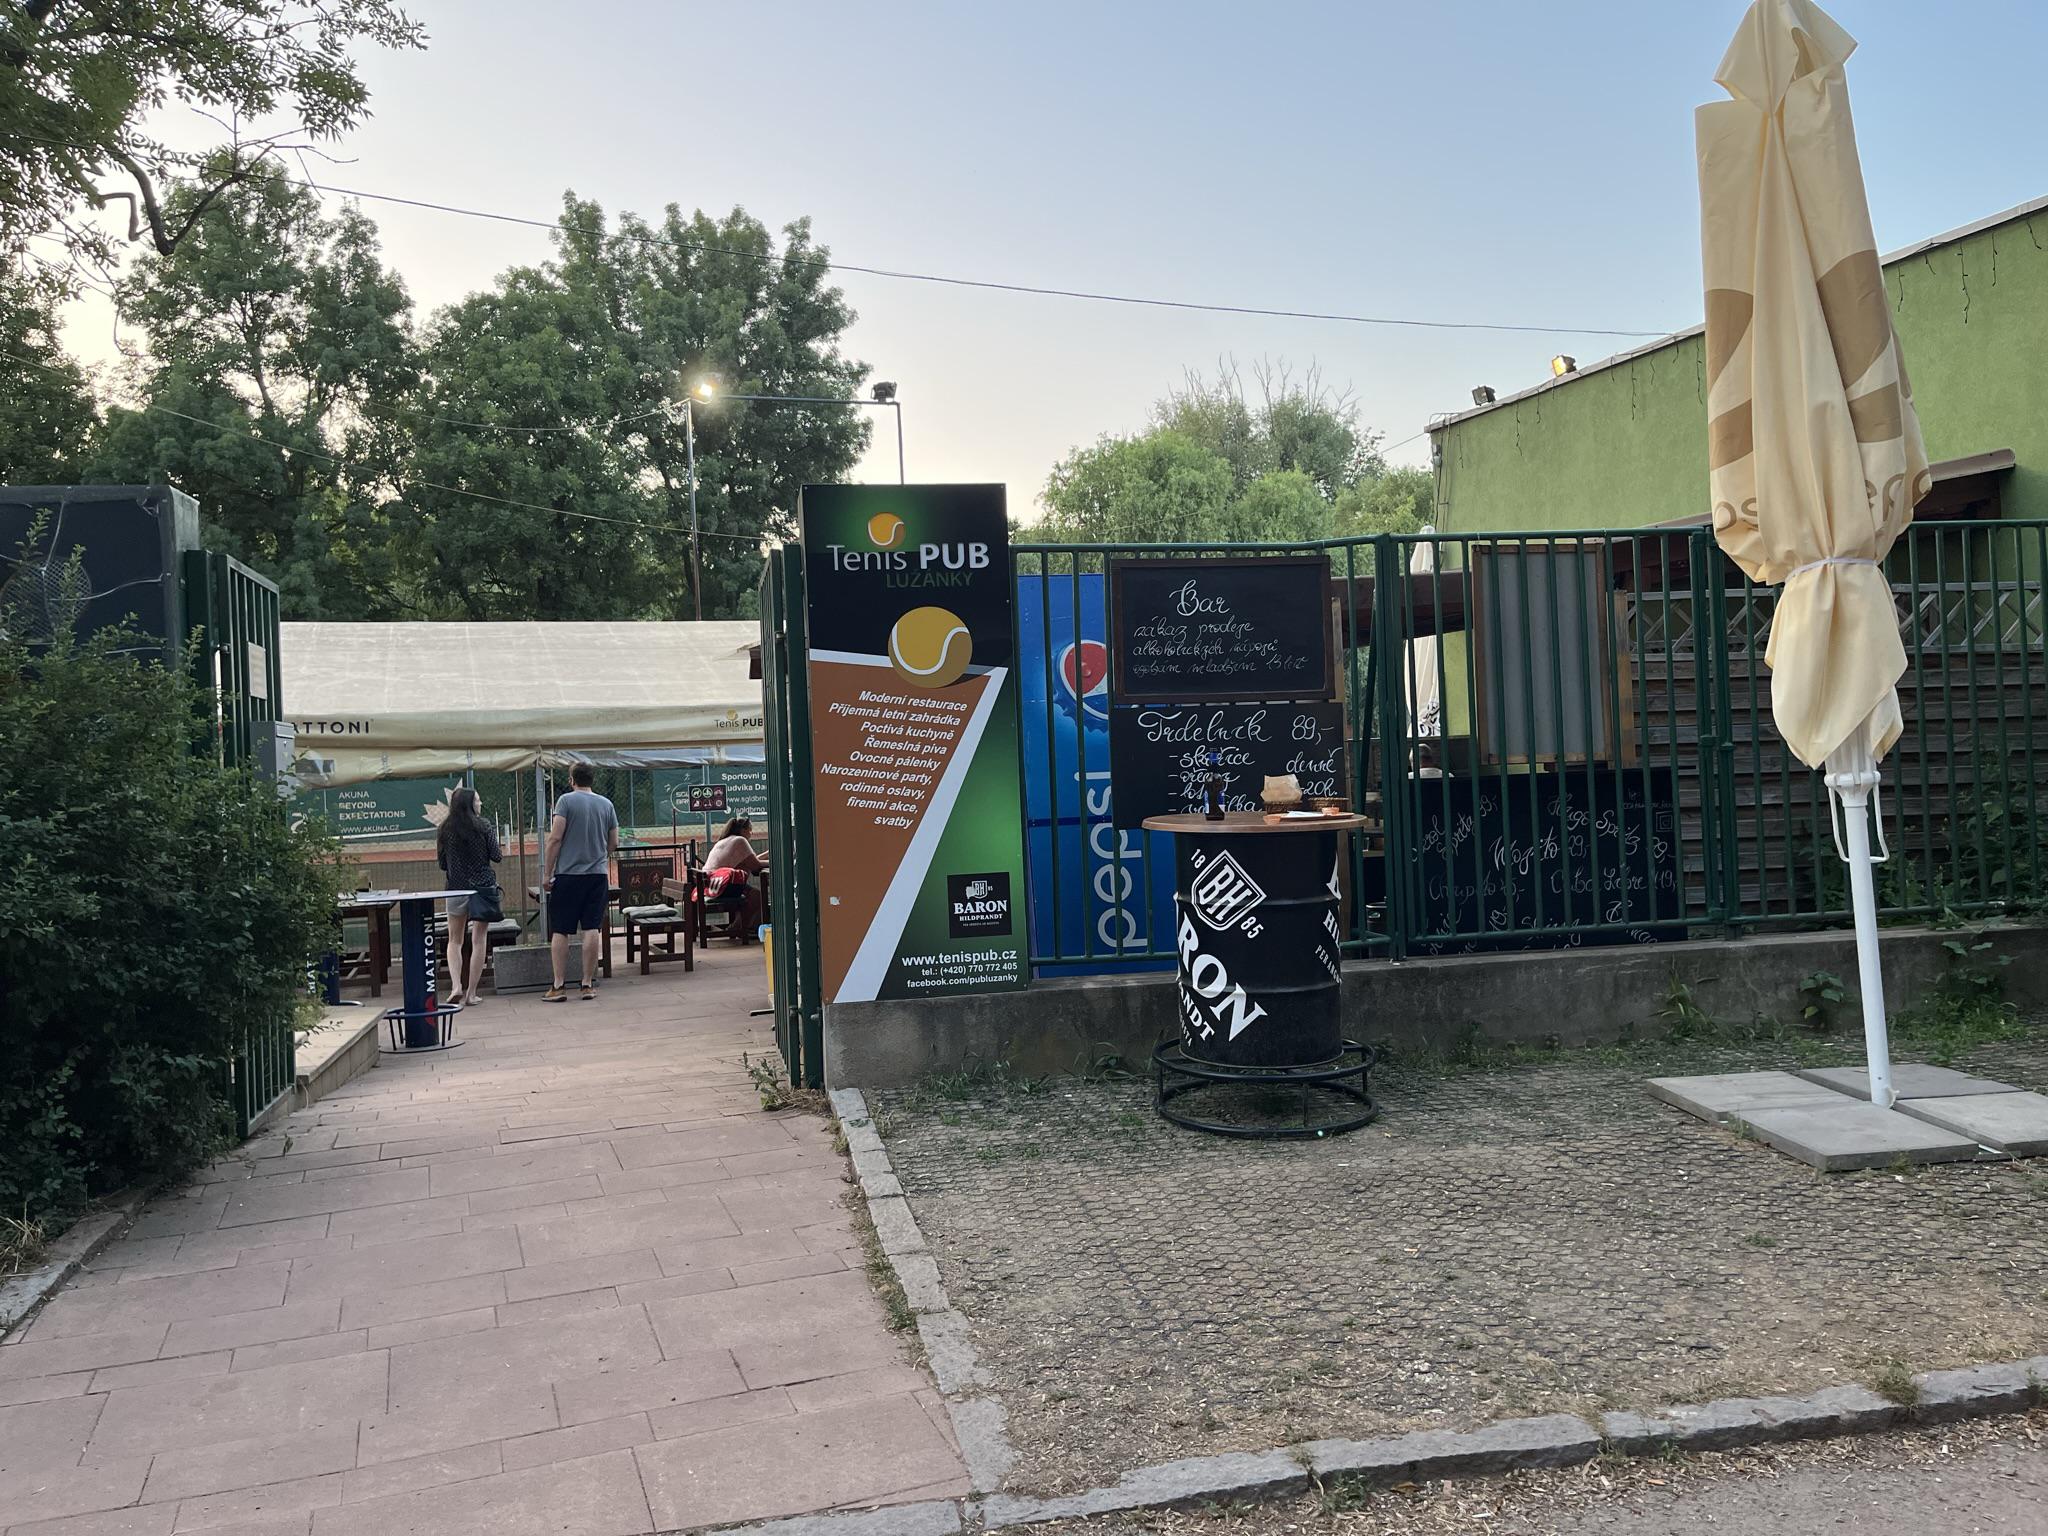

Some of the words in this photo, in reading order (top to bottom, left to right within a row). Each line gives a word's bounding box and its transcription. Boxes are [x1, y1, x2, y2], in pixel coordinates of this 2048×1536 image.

[826, 544, 907, 571] Tenis
[920, 542, 990, 570] PUB
[886, 568, 973, 588] LUŽÁNKY
[1169, 579, 1230, 616] Bar
[859, 691, 907, 705] Moderní
[908, 698, 968, 711] restaurace
[714, 719, 740, 728] Tenis
[742, 718, 763, 727] PUB
[829, 702, 879, 719] Příjemná
[882, 708, 908, 721] letní
[909, 712, 961, 726] zahrádka
[291, 721, 369, 734] ATTONI
[860, 721, 903, 735] Poctivá
[906, 727, 954, 741] kuchyně
[864, 735, 920, 751] Řemeslná
[922, 743, 947, 755] piva
[850, 751, 893, 765] Ovocné
[895, 756, 941, 771] pálenky
[1286, 747, 1343, 773] denně
[821, 763, 899, 781] Narozeninové
[900, 773, 932, 785] party,
[338, 791, 369, 799] AKUNA
[727, 783, 753, 792] udvíka
[840, 782, 885, 794] rodinné
[887, 786, 925, 800] oslavy,
[338, 801, 376, 810] BEYOND
[339, 810, 406, 820] EXPECTATIONS
[847, 796, 888, 808] firemní
[889, 801, 918, 814] akce,
[341, 824, 400, 834] WWW.AKUNA.CZ
[874, 814, 913, 830] svatby
[1190, 848, 1206, 869] 18
[1198, 864, 1253, 921] BH
[953, 900, 1008, 915] BARON
[960, 913, 1003, 922] HILDPRANDT
[1240, 915, 1265, 939] 85
[423, 917, 436, 992] MATTONI
[902, 949, 1017, 967] www.tenispub.cz
[1315, 944, 1329, 965] PER
[940, 965, 967, 976] (+420)
[968, 964, 983, 973] 770
[985, 963, 1000, 972] 772
[1002, 962, 1018, 971] 405
[1176, 908, 1268, 1042] RON
[907, 973, 1018, 988] facebook.com/publuzanky
